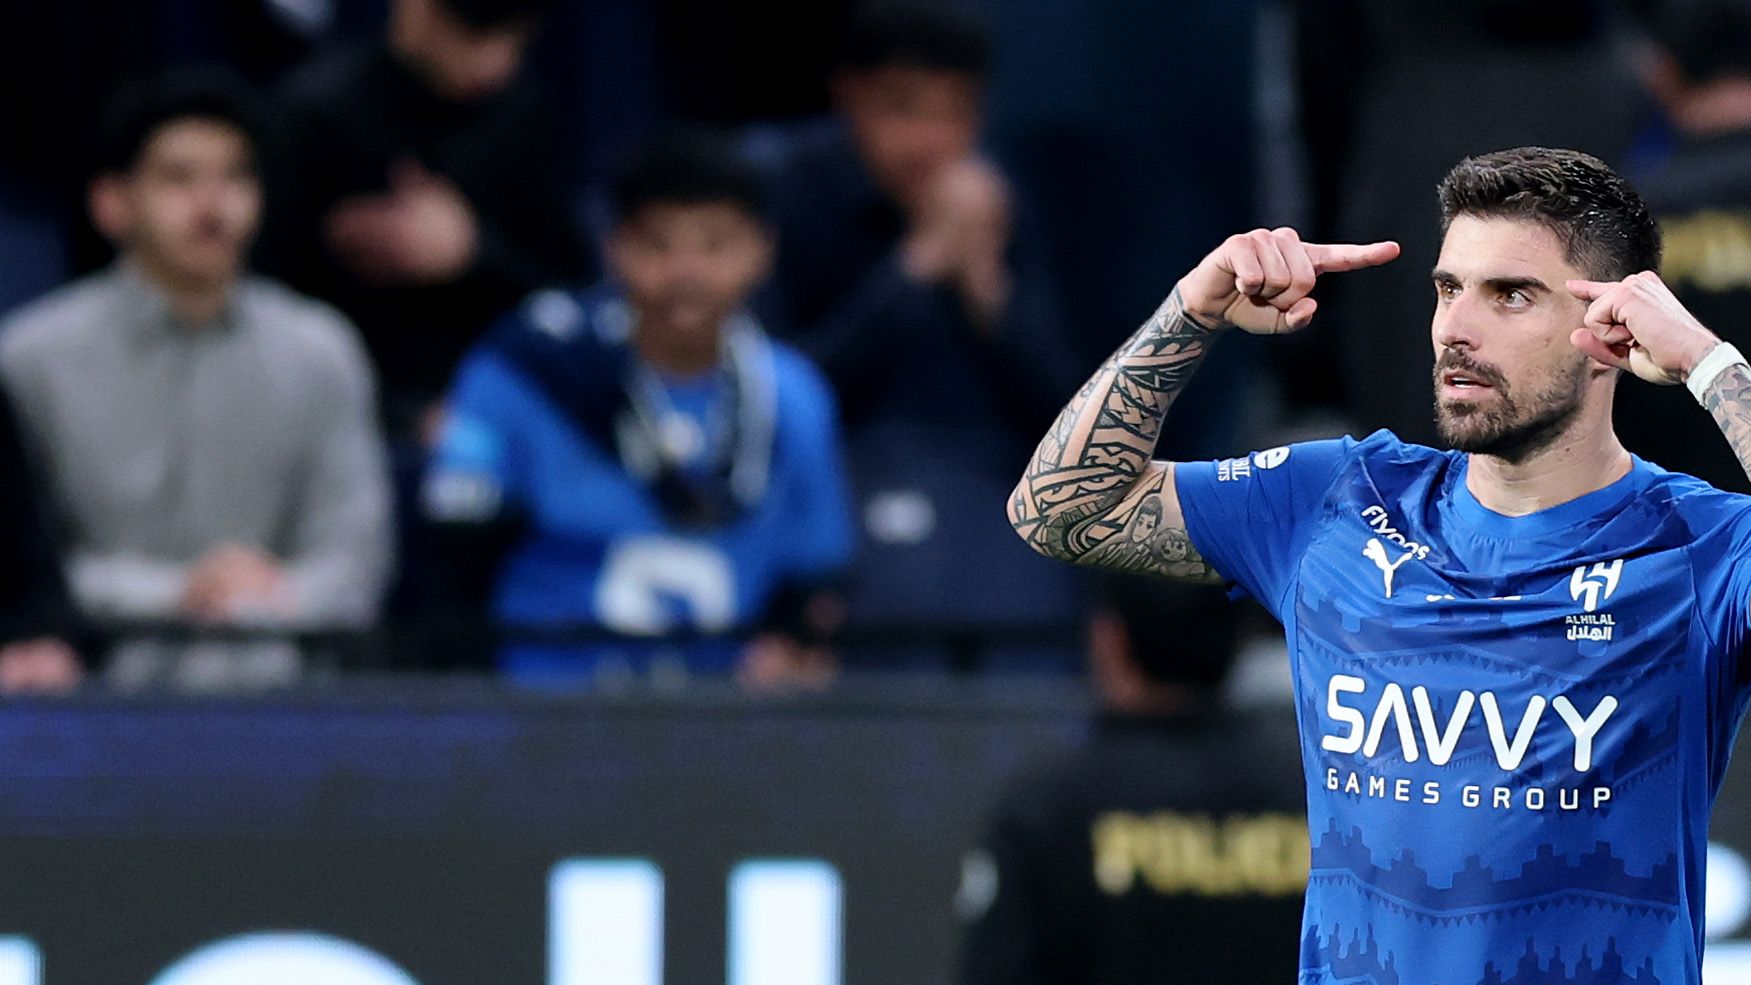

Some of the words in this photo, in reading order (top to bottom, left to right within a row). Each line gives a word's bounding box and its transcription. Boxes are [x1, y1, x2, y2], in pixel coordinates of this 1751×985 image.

[1321, 674, 1618, 772] SAVVY
[1327, 768, 1440, 804] GAMES
[1462, 784, 1611, 810] GROUP
